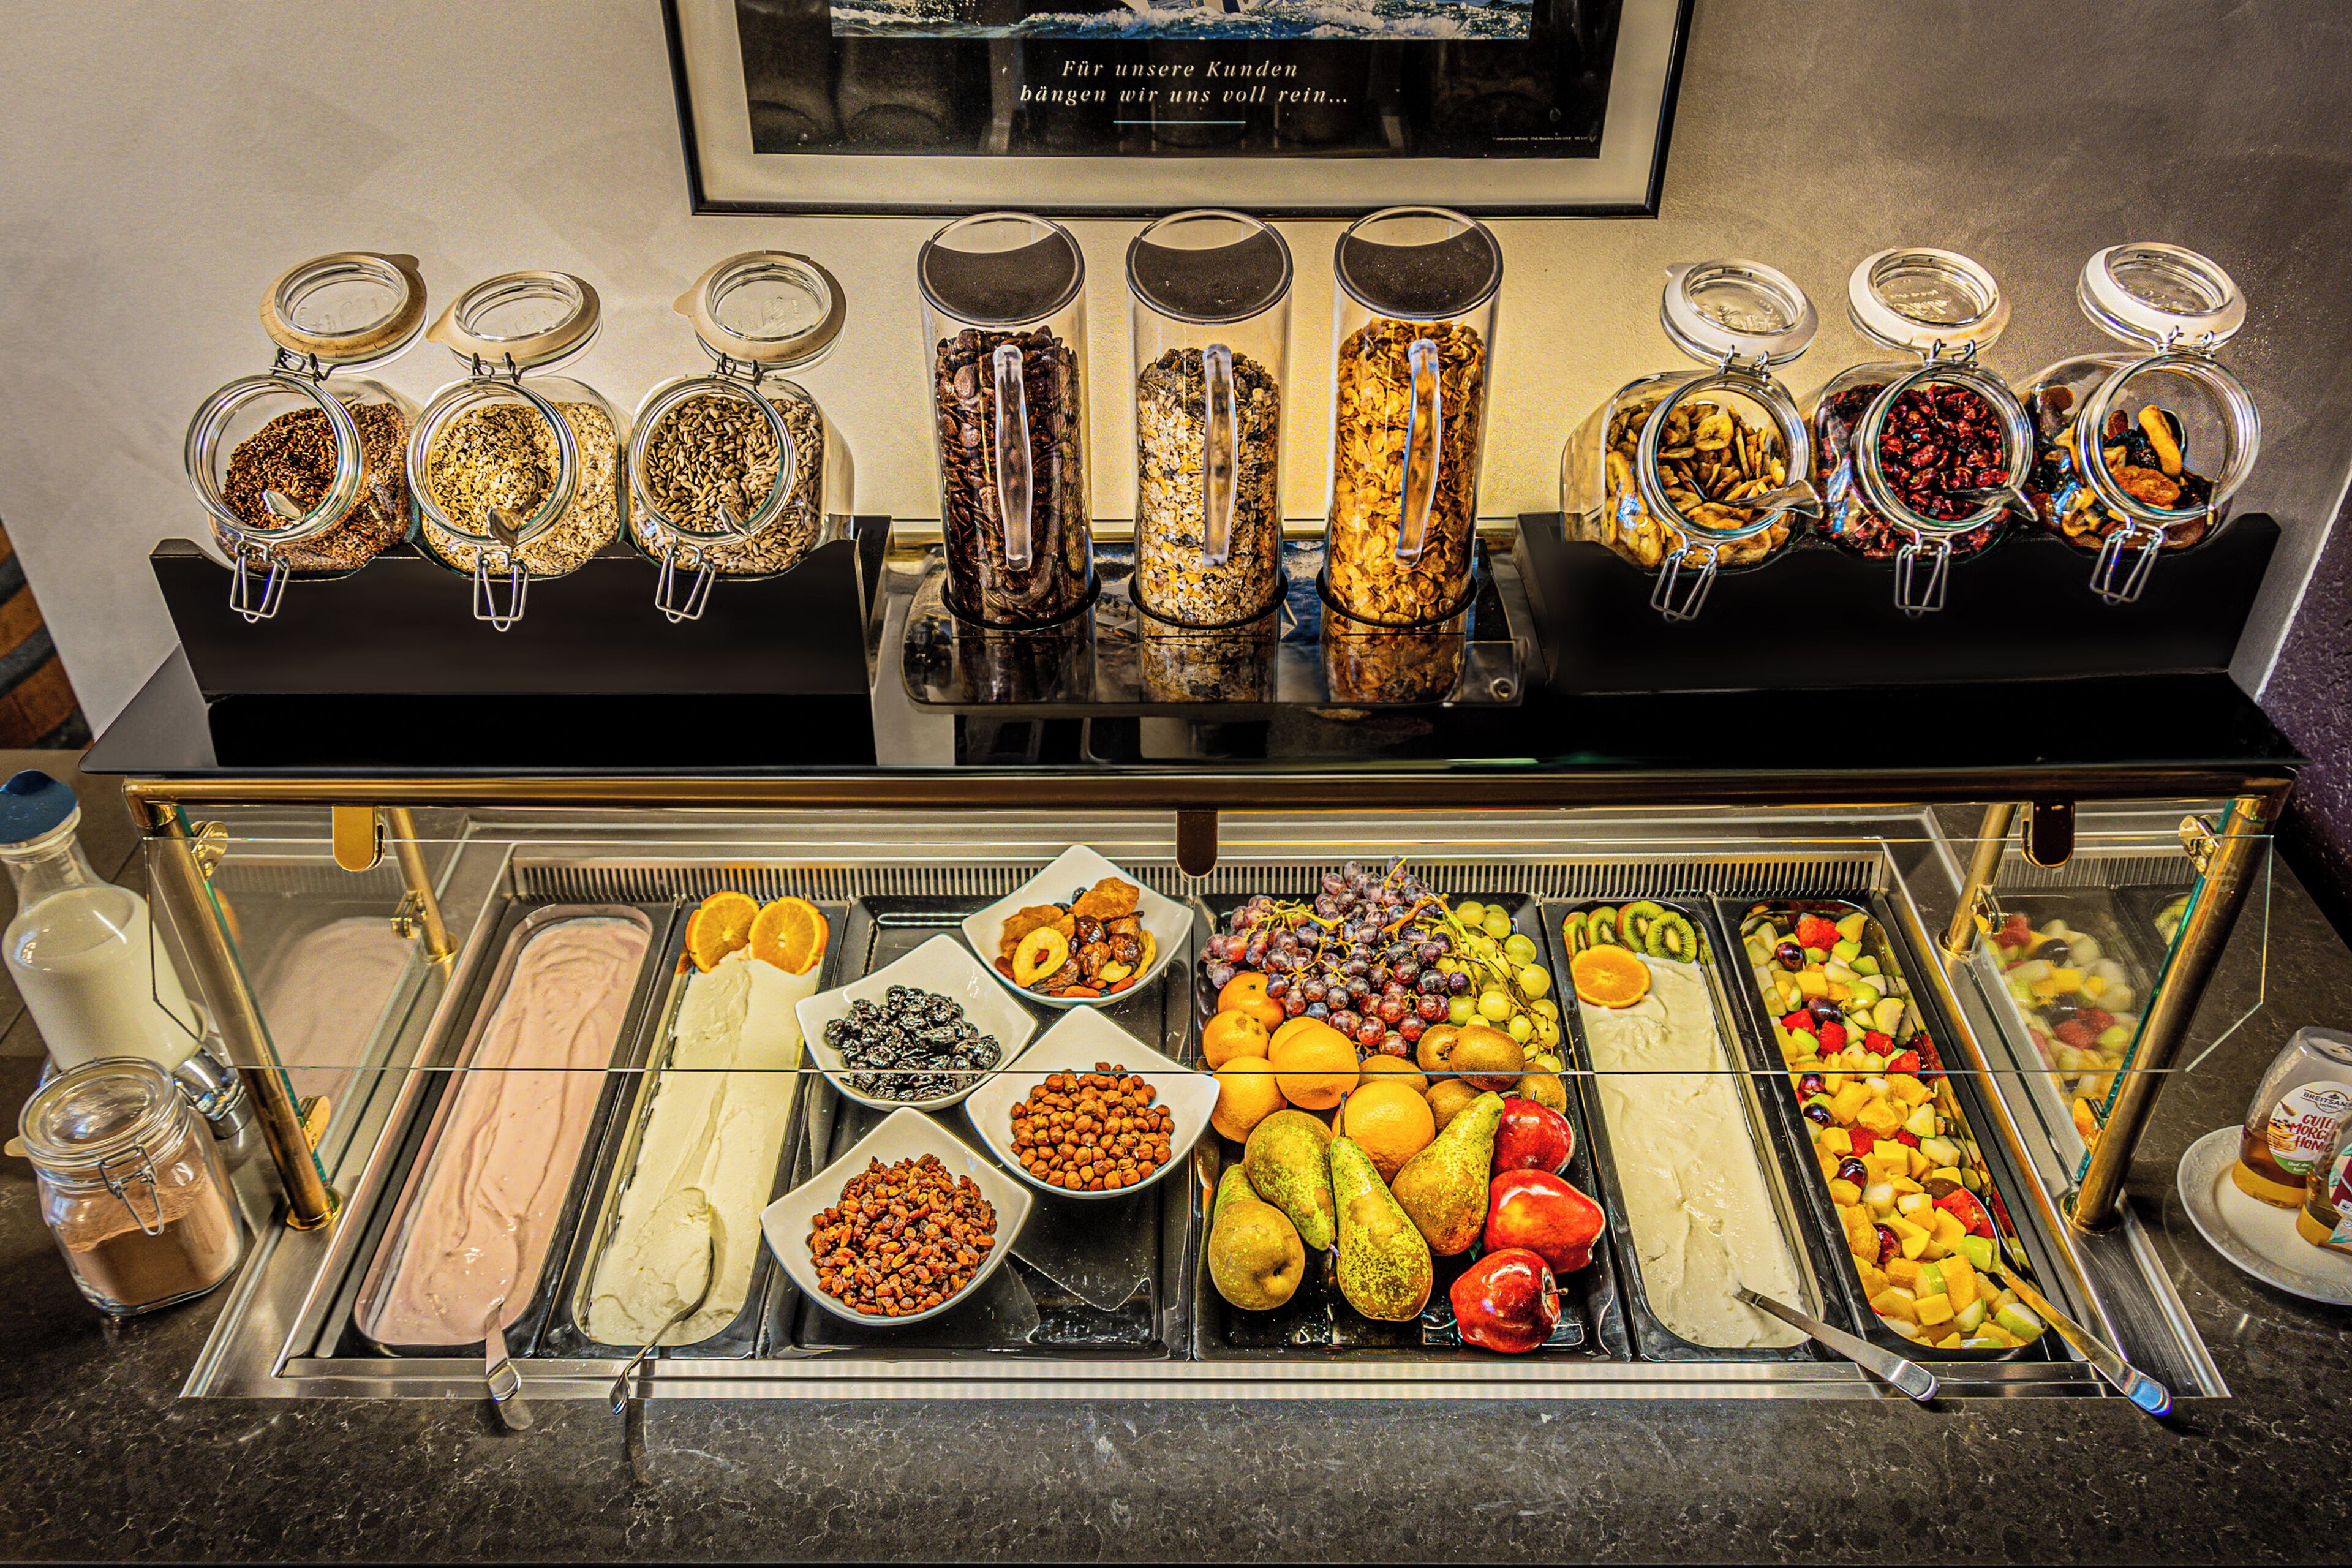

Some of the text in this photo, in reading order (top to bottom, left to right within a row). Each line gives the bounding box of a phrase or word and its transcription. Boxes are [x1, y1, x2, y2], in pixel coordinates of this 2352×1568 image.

[1061, 61, 1297, 77] Für unsere Kunden
[1019, 85, 1348, 105] hängen wir uns voll rein...
[2303, 1091, 2351, 1107] BREITSAM
[2289, 1122, 2337, 1142] MORG
